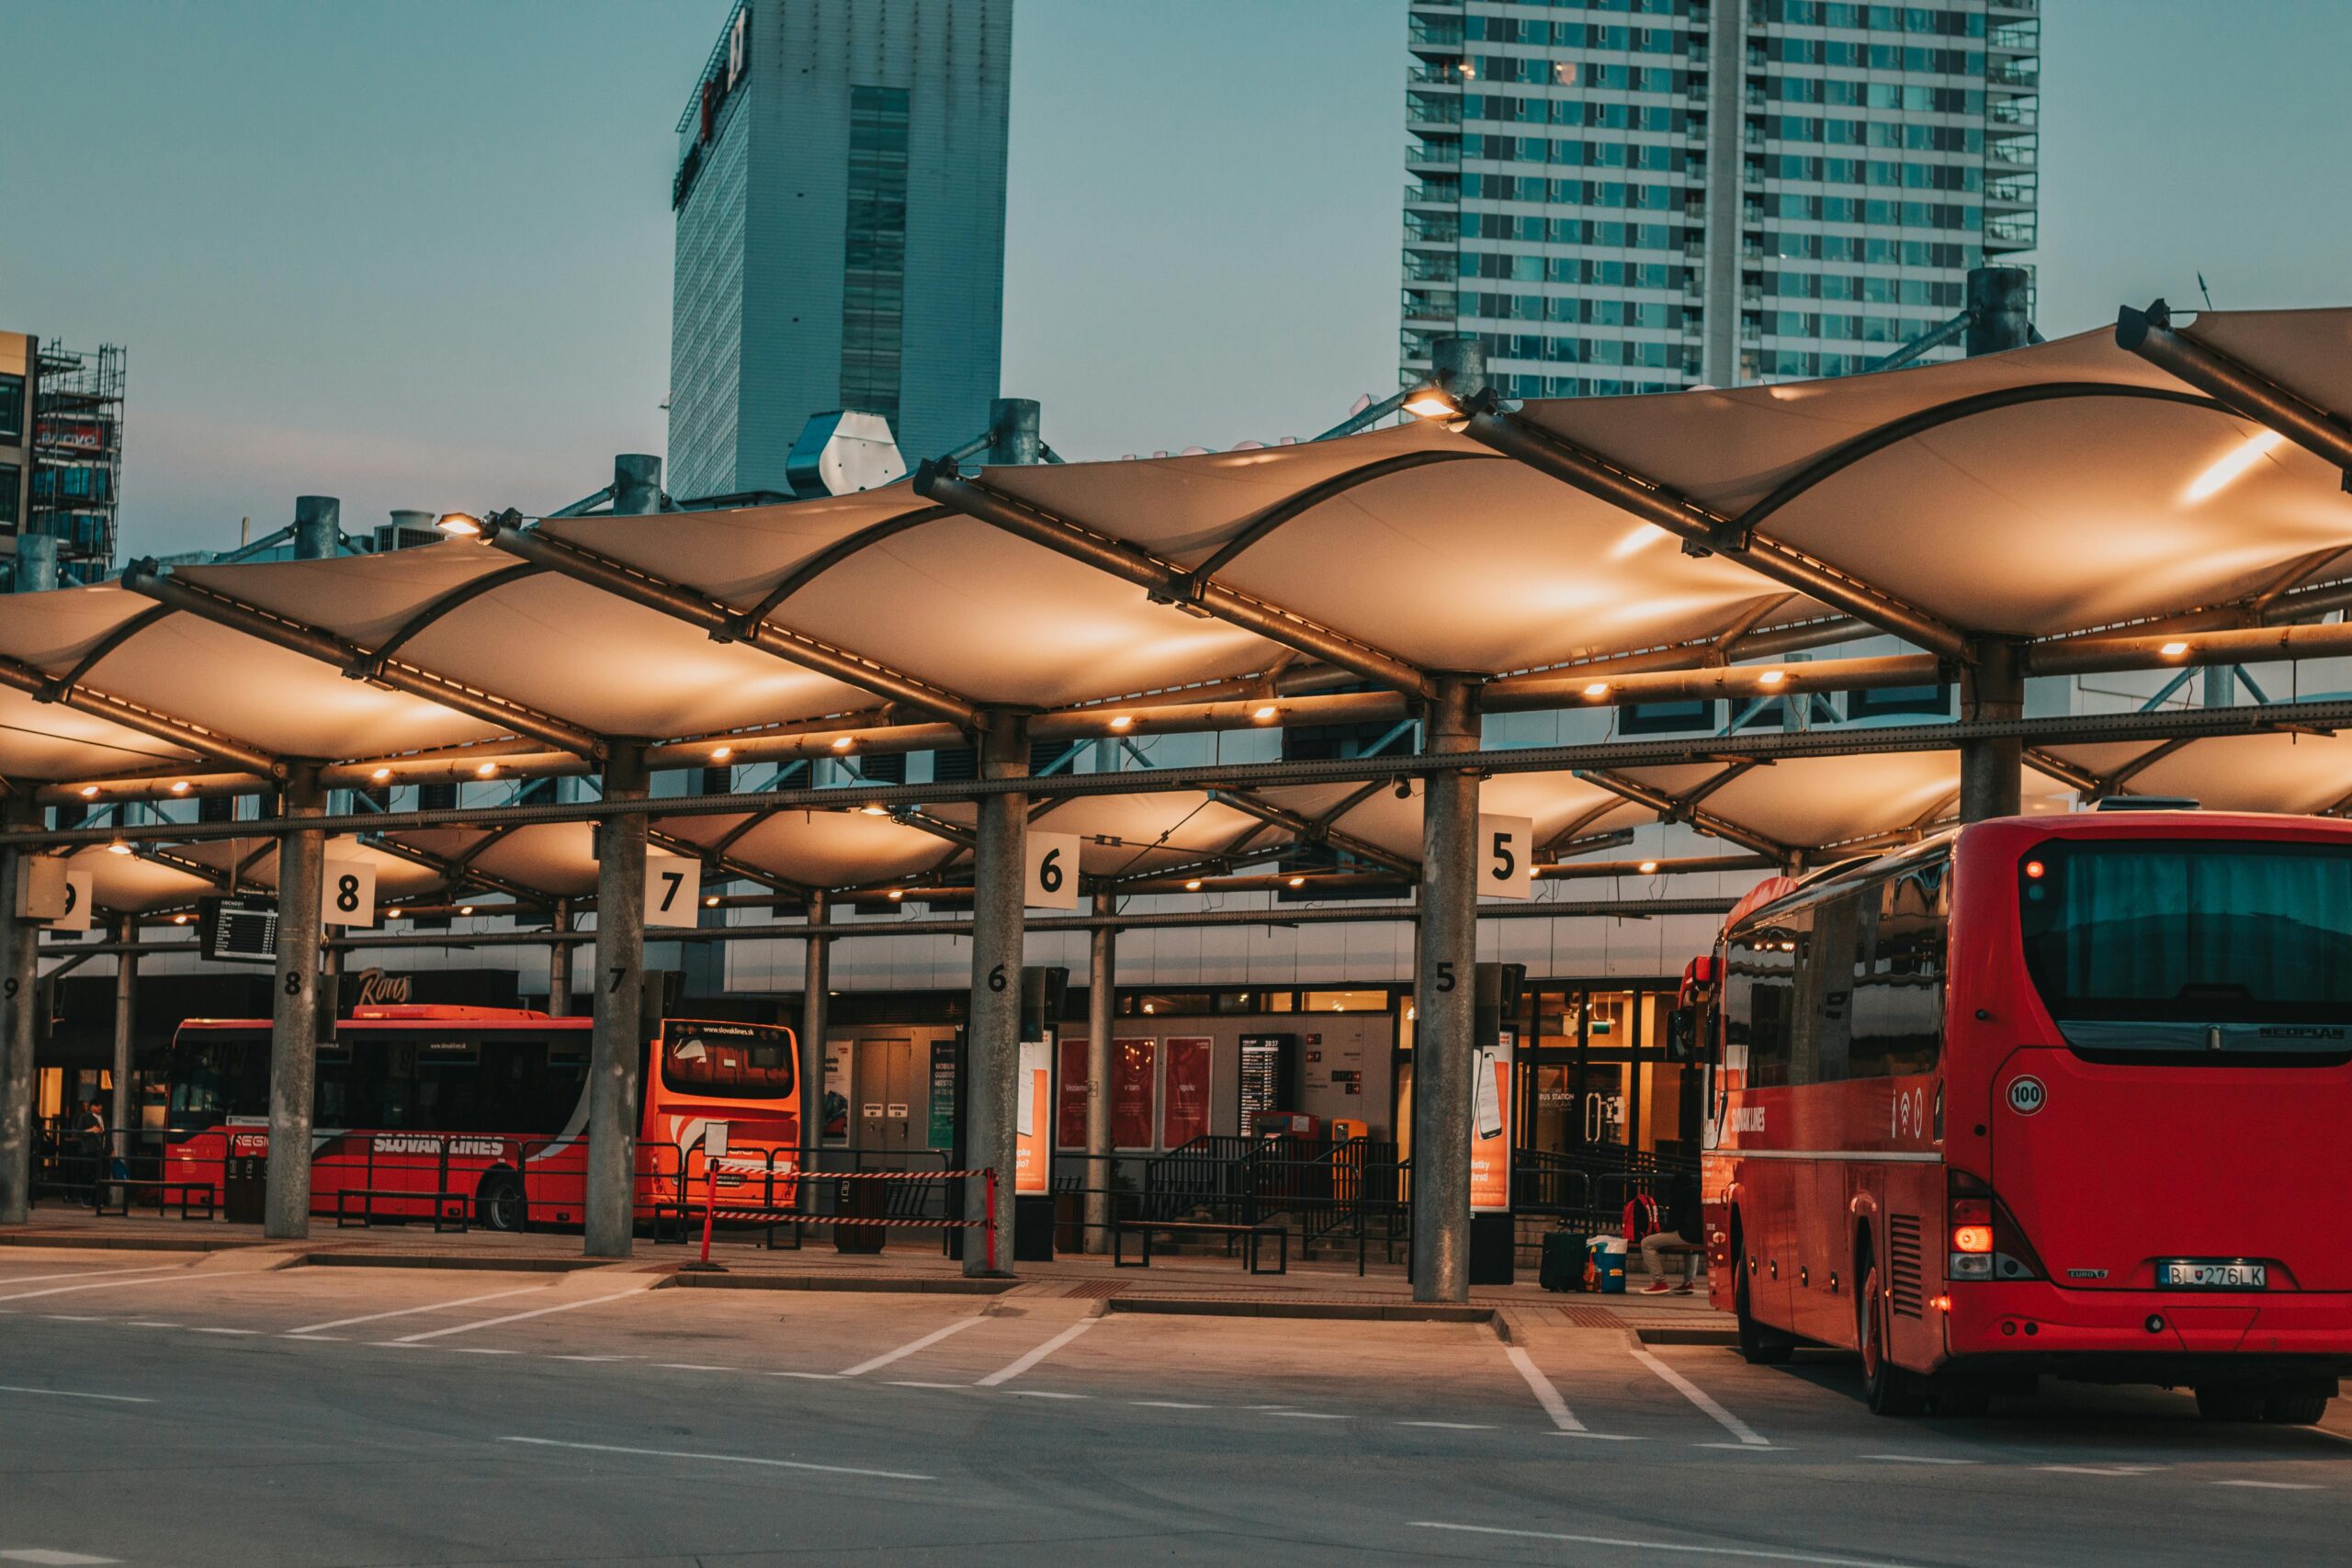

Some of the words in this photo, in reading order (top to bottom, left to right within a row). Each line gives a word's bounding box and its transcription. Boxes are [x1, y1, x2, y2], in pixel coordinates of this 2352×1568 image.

[1492, 832, 1515, 881] 5
[1040, 848, 1063, 893] 6
[336, 874, 359, 912] 8
[660, 872, 684, 912] 7
[4, 976, 18, 1000] 9
[284, 971, 301, 996] 8
[609, 967, 627, 993] 7
[988, 964, 1007, 992] 6
[1436, 962, 1455, 993] 5
[703, 1026, 754, 1036] www.slovaklines.sk
[2259, 1027, 2345, 1039] NEOPLAN
[2014, 1086, 2041, 1102] 100
[1732, 1107, 1750, 1132] SLOVAK
[1750, 1106, 1765, 1132] LINES
[448, 1134, 504, 1156] LINES
[2171, 1268, 2194, 1285] BL
[2205, 1268, 2263, 1286] 276LK
